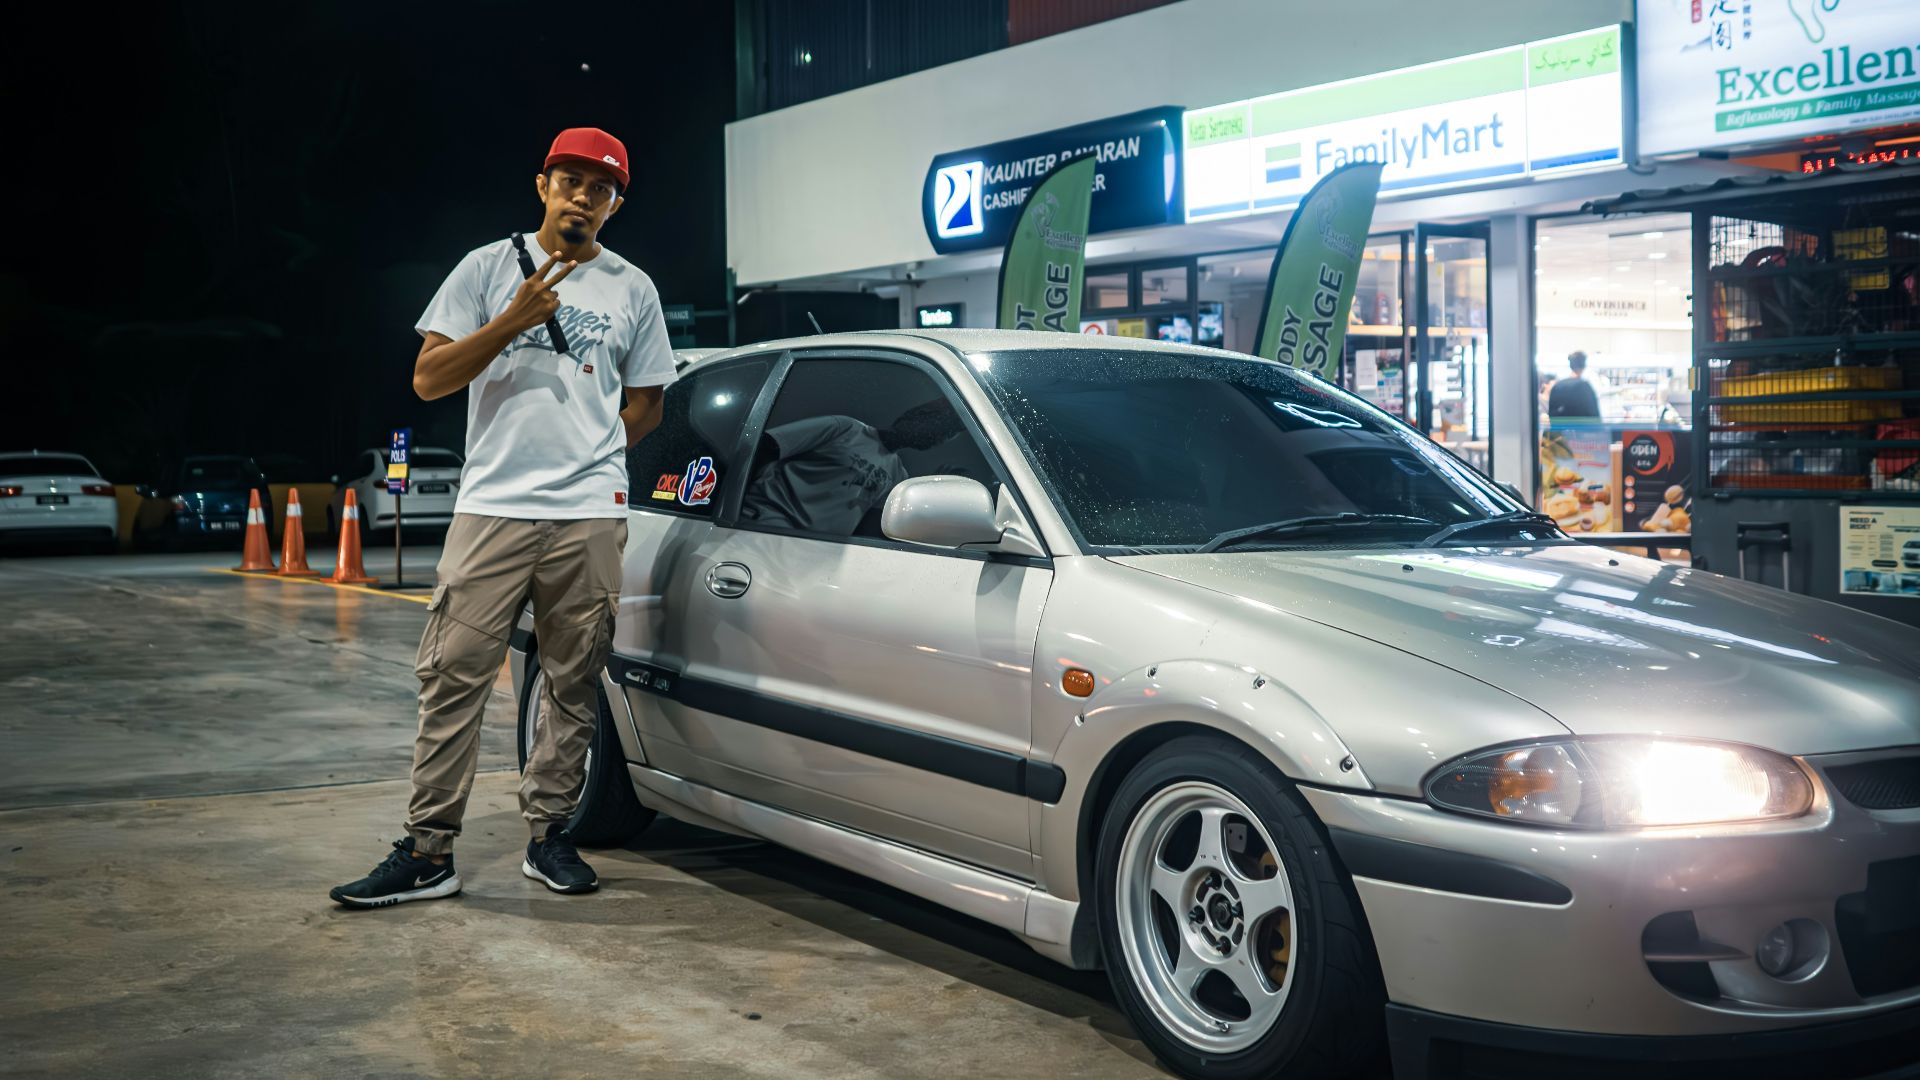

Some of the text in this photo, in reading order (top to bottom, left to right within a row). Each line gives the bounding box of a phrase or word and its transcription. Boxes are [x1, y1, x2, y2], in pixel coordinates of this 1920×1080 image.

[1715, 44, 1920, 105] Excellen
[1726, 106, 1798, 127] Reflexology
[1801, 102, 1813, 116] &
[1815, 94, 1861, 113] Family
[1315, 112, 1504, 175] FamilyMart
[984, 153, 1057, 185] KAUNTER
[984, 186, 1032, 210] CASHIE
[1573, 298, 1647, 311] CONVENIENCE
[390, 449, 406, 463] POLIS
[1630, 444, 1658, 456] ODEN
[681, 457, 713, 504] VP
